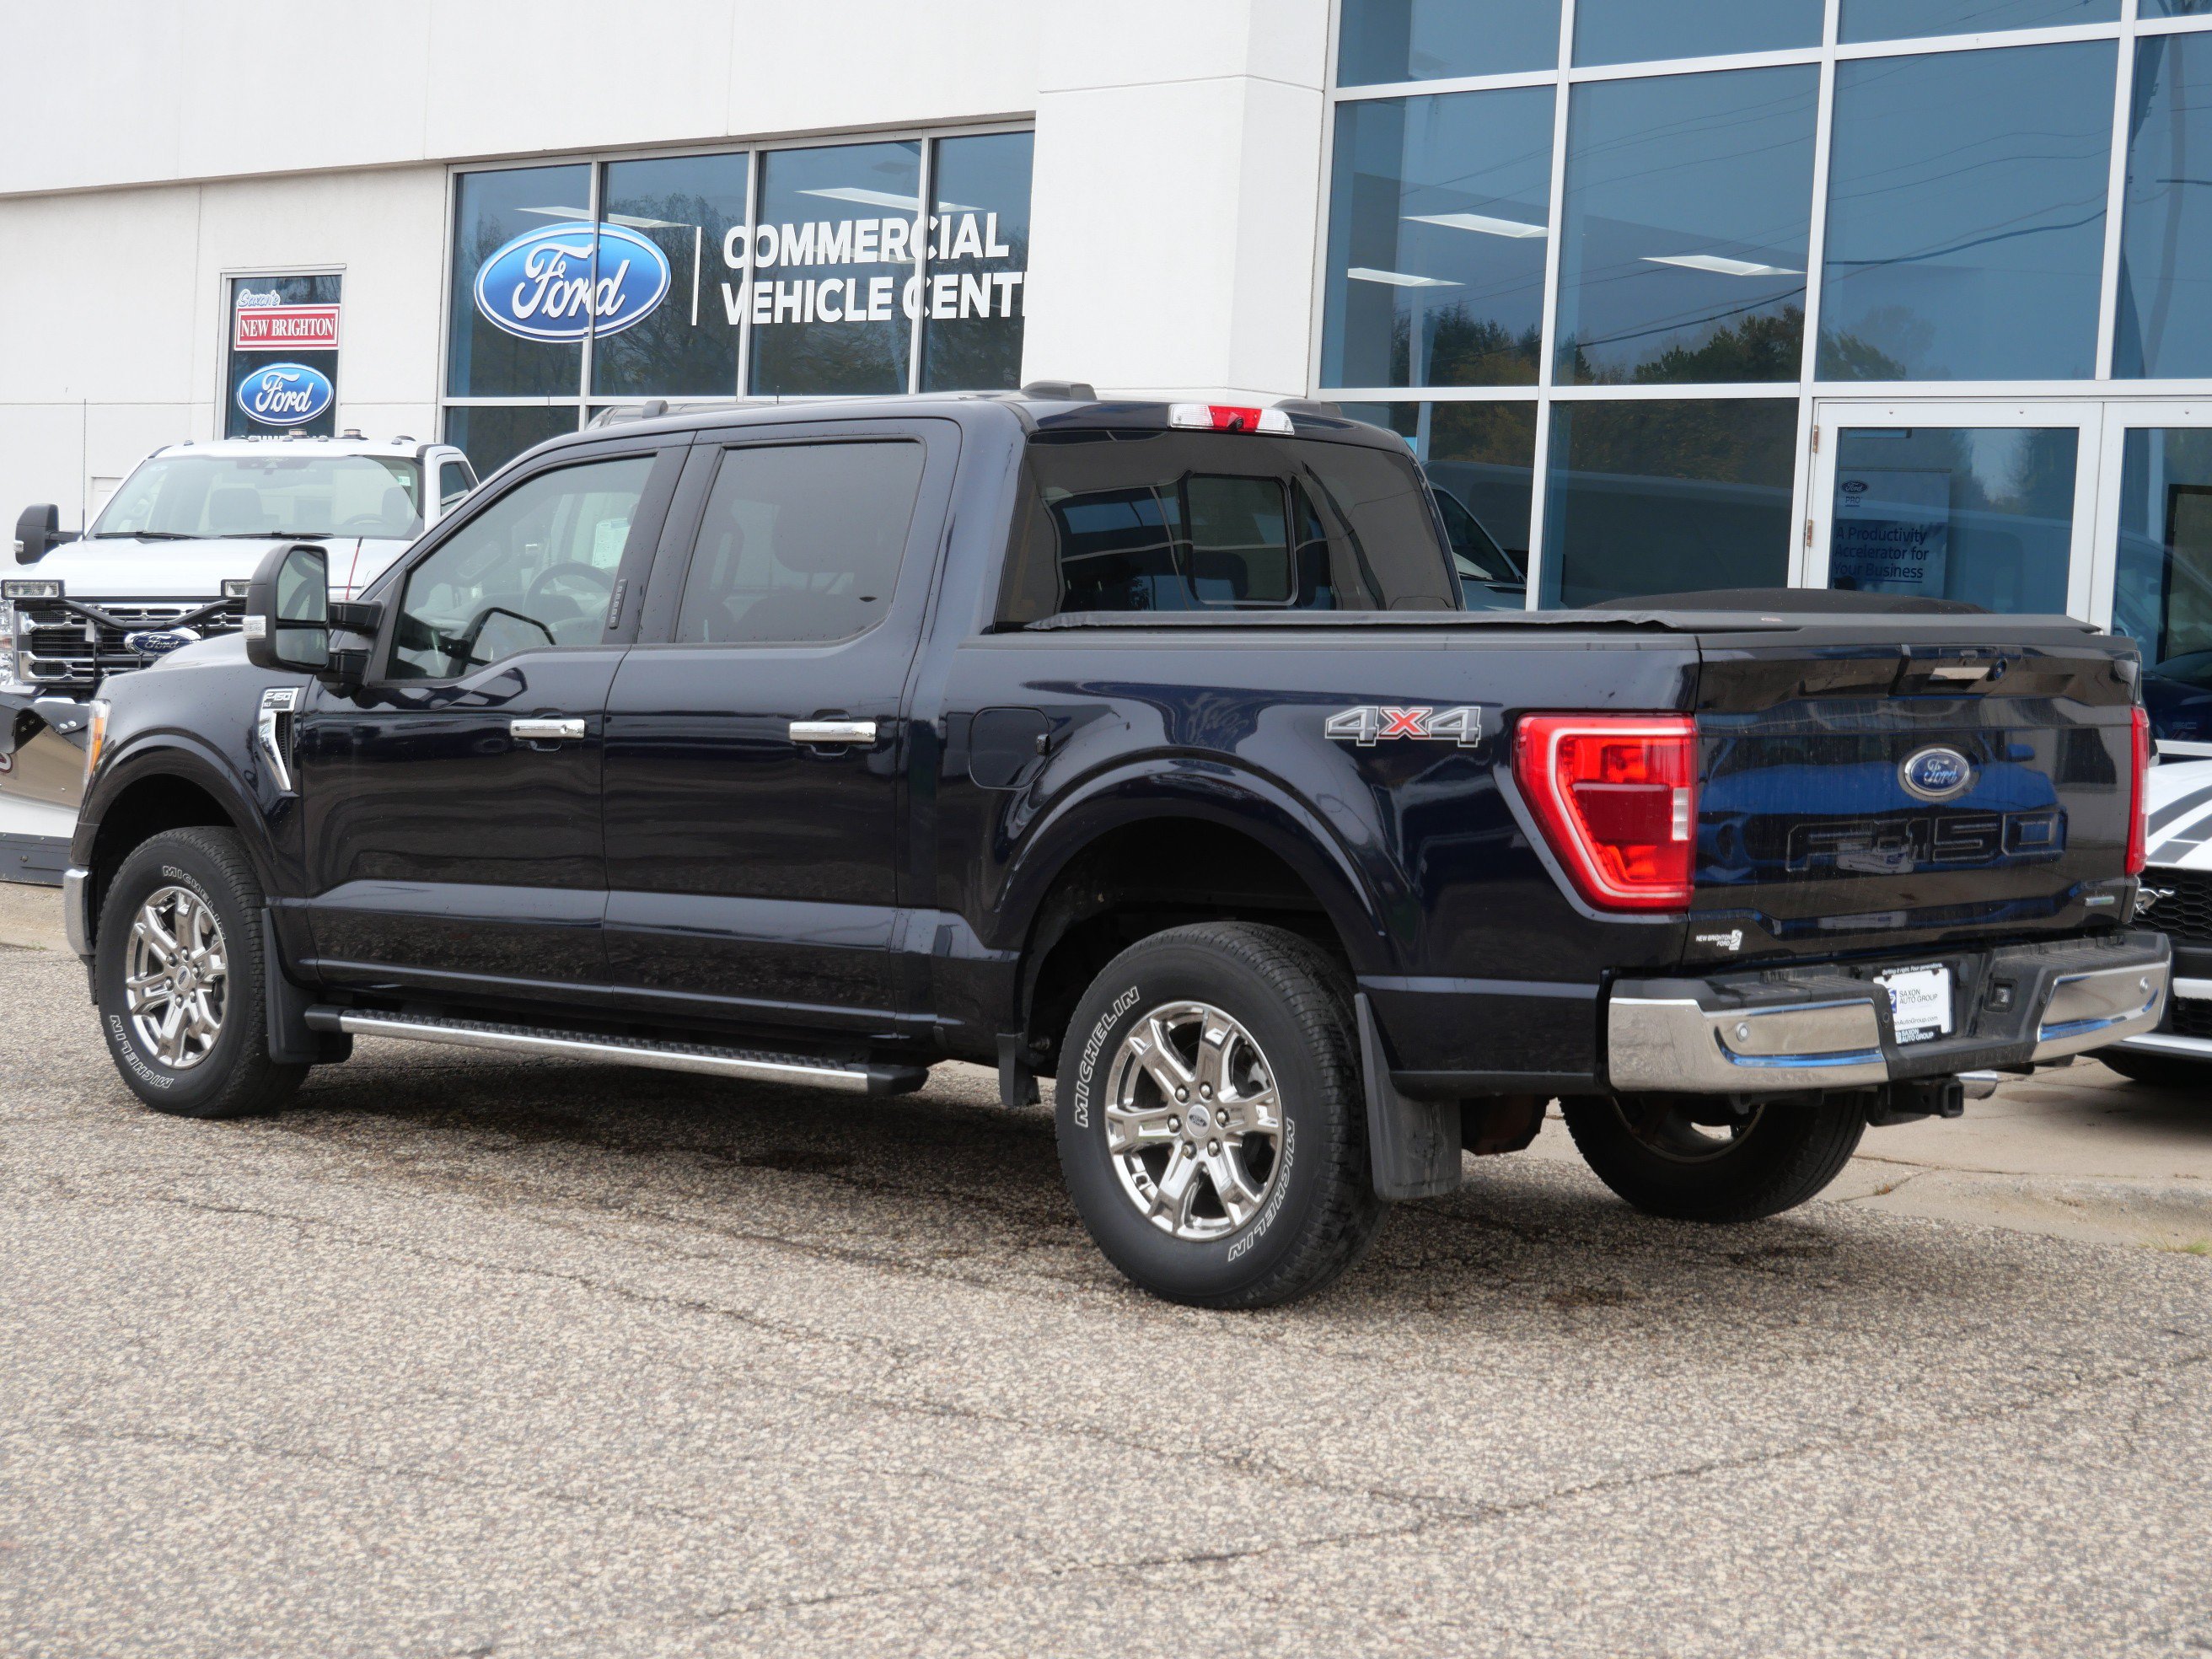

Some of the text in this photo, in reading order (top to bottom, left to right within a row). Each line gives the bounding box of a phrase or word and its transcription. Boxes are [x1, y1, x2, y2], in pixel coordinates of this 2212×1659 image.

[723, 212, 1010, 269] COMMERCIAL
[512, 243, 631, 319] Ford
[238, 289, 279, 307] Saxon's
[721, 271, 1028, 325] VEHICLE CENT
[240, 318, 335, 337] NEW BRIGHTON
[255, 371, 314, 413] Ford
[1844, 496, 1860, 504] PRO
[1834, 526, 1928, 545] A Productivity
[1834, 544, 1930, 561] Accelerator for
[1833, 561, 1924, 578] Your Business
[144, 635, 180, 650] Ford
[1923, 759, 1958, 785] Ford
[1785, 807, 2067, 872] F-150
[162, 865, 227, 942] MICHELIN
[1708, 933, 1731, 942] BRIGHTON
[1899, 989, 1920, 998] SAXON
[1899, 993, 1938, 1005] AUTO GROUP
[1901, 1028, 1919, 1036] SAXON
[1901, 1031, 1934, 1043] AUTO GROUP
[110, 1015, 174, 1088] MICHELIN
[1075, 985, 1140, 1129] MICHELIN
[1228, 1117, 1296, 1262] MICHELIN
